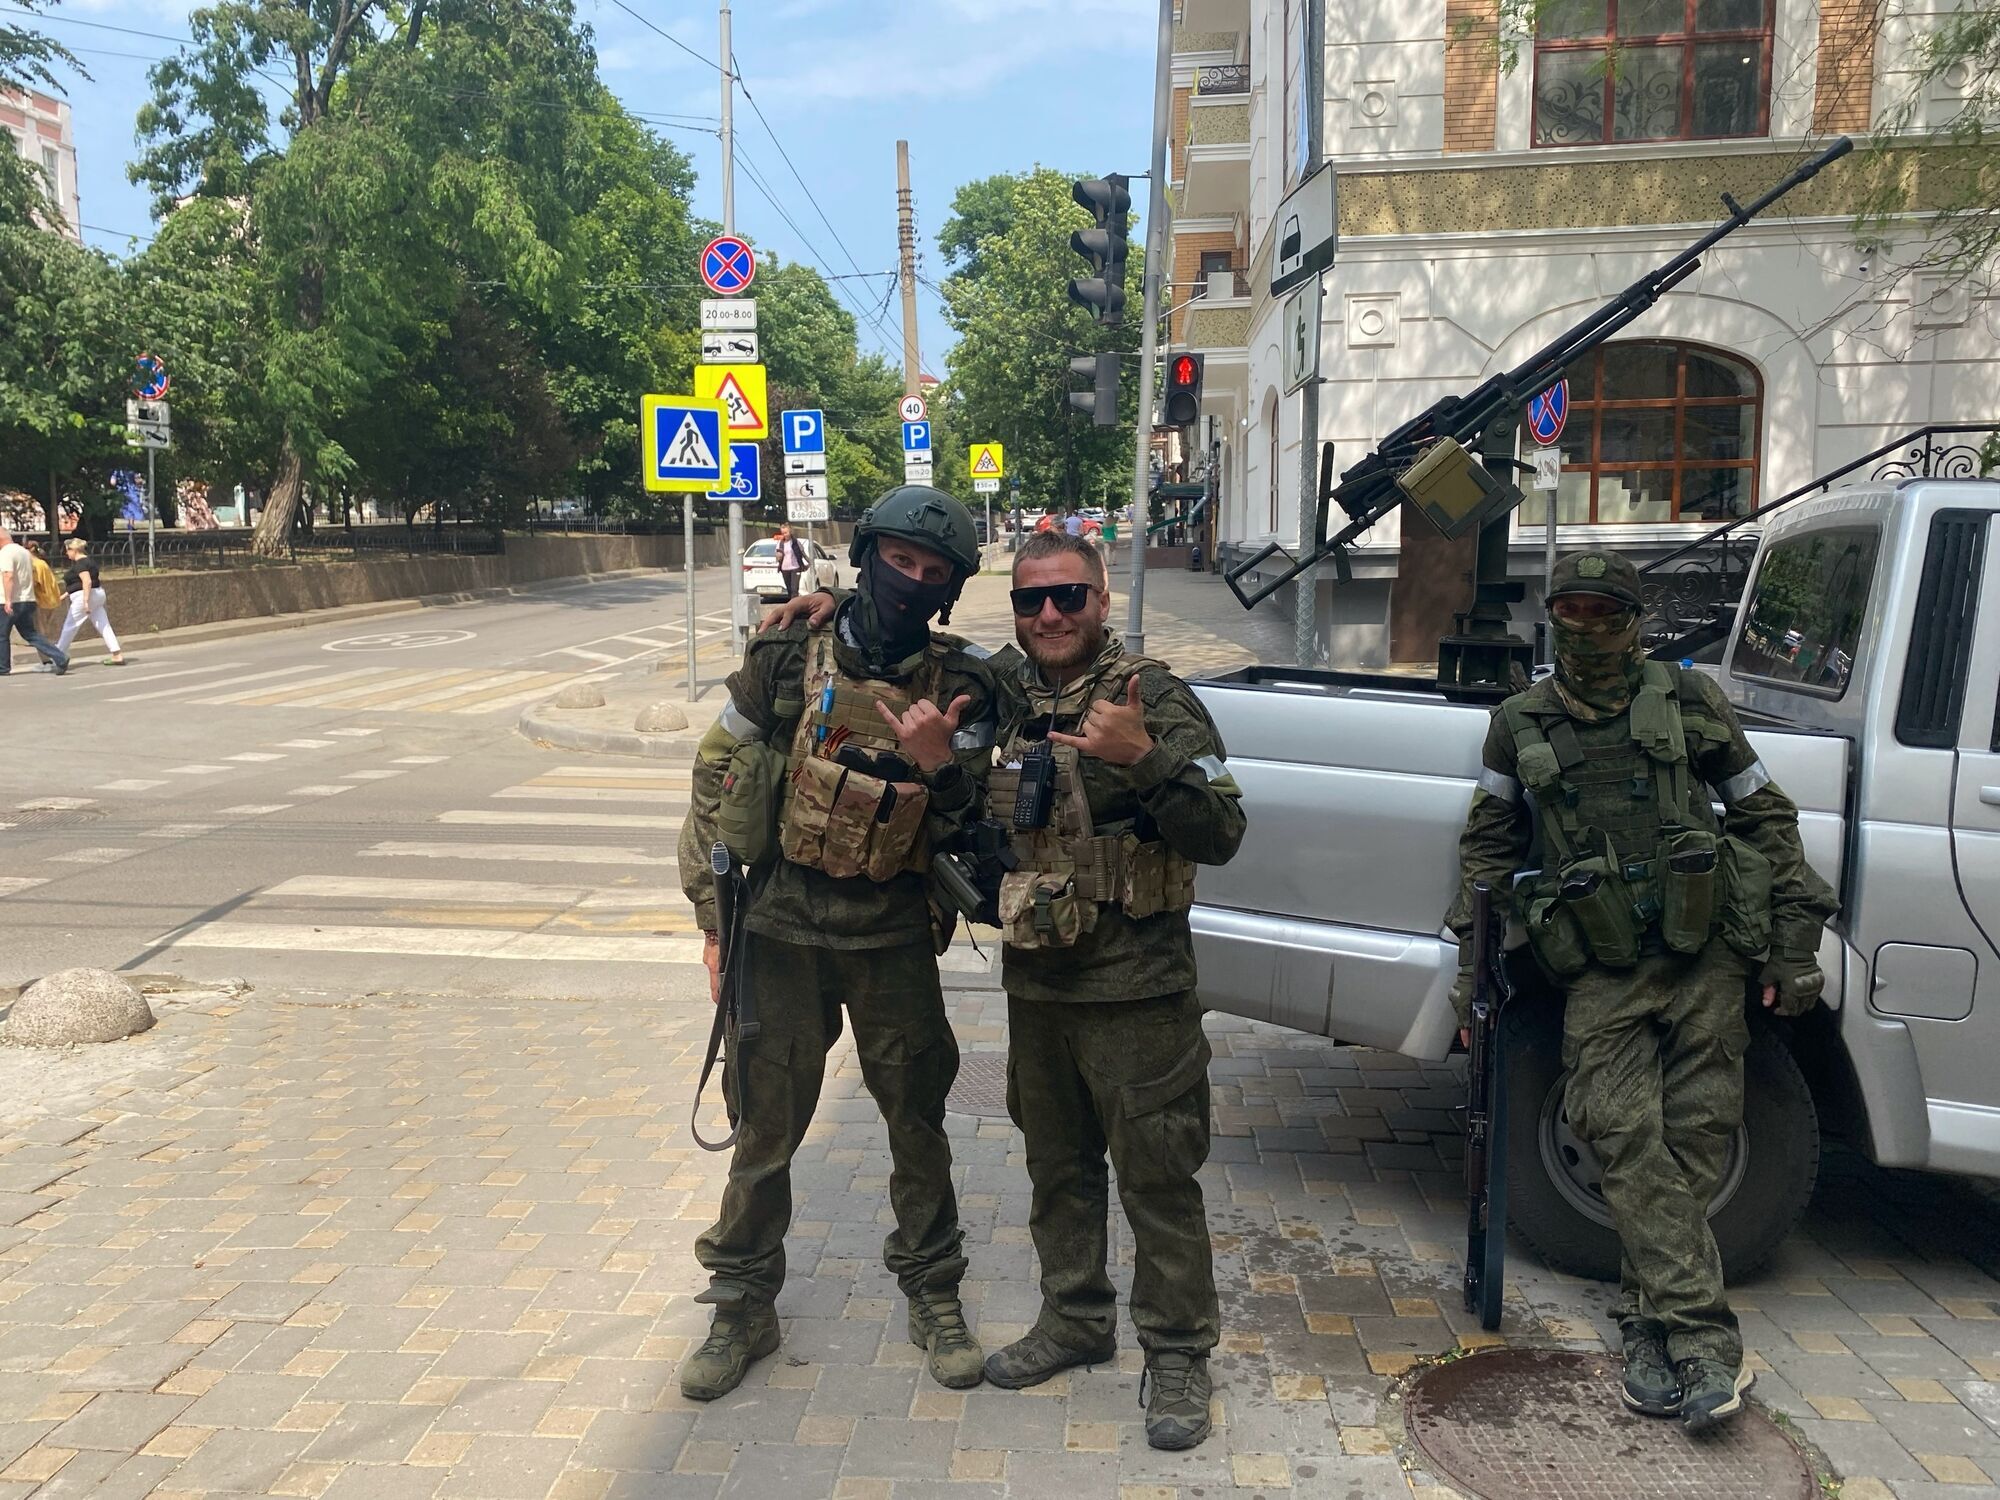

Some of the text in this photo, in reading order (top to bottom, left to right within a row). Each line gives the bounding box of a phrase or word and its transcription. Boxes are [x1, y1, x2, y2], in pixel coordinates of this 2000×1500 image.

[906, 403, 920, 414] 40
[793, 415, 816, 449] P
[910, 425, 926, 448] P
